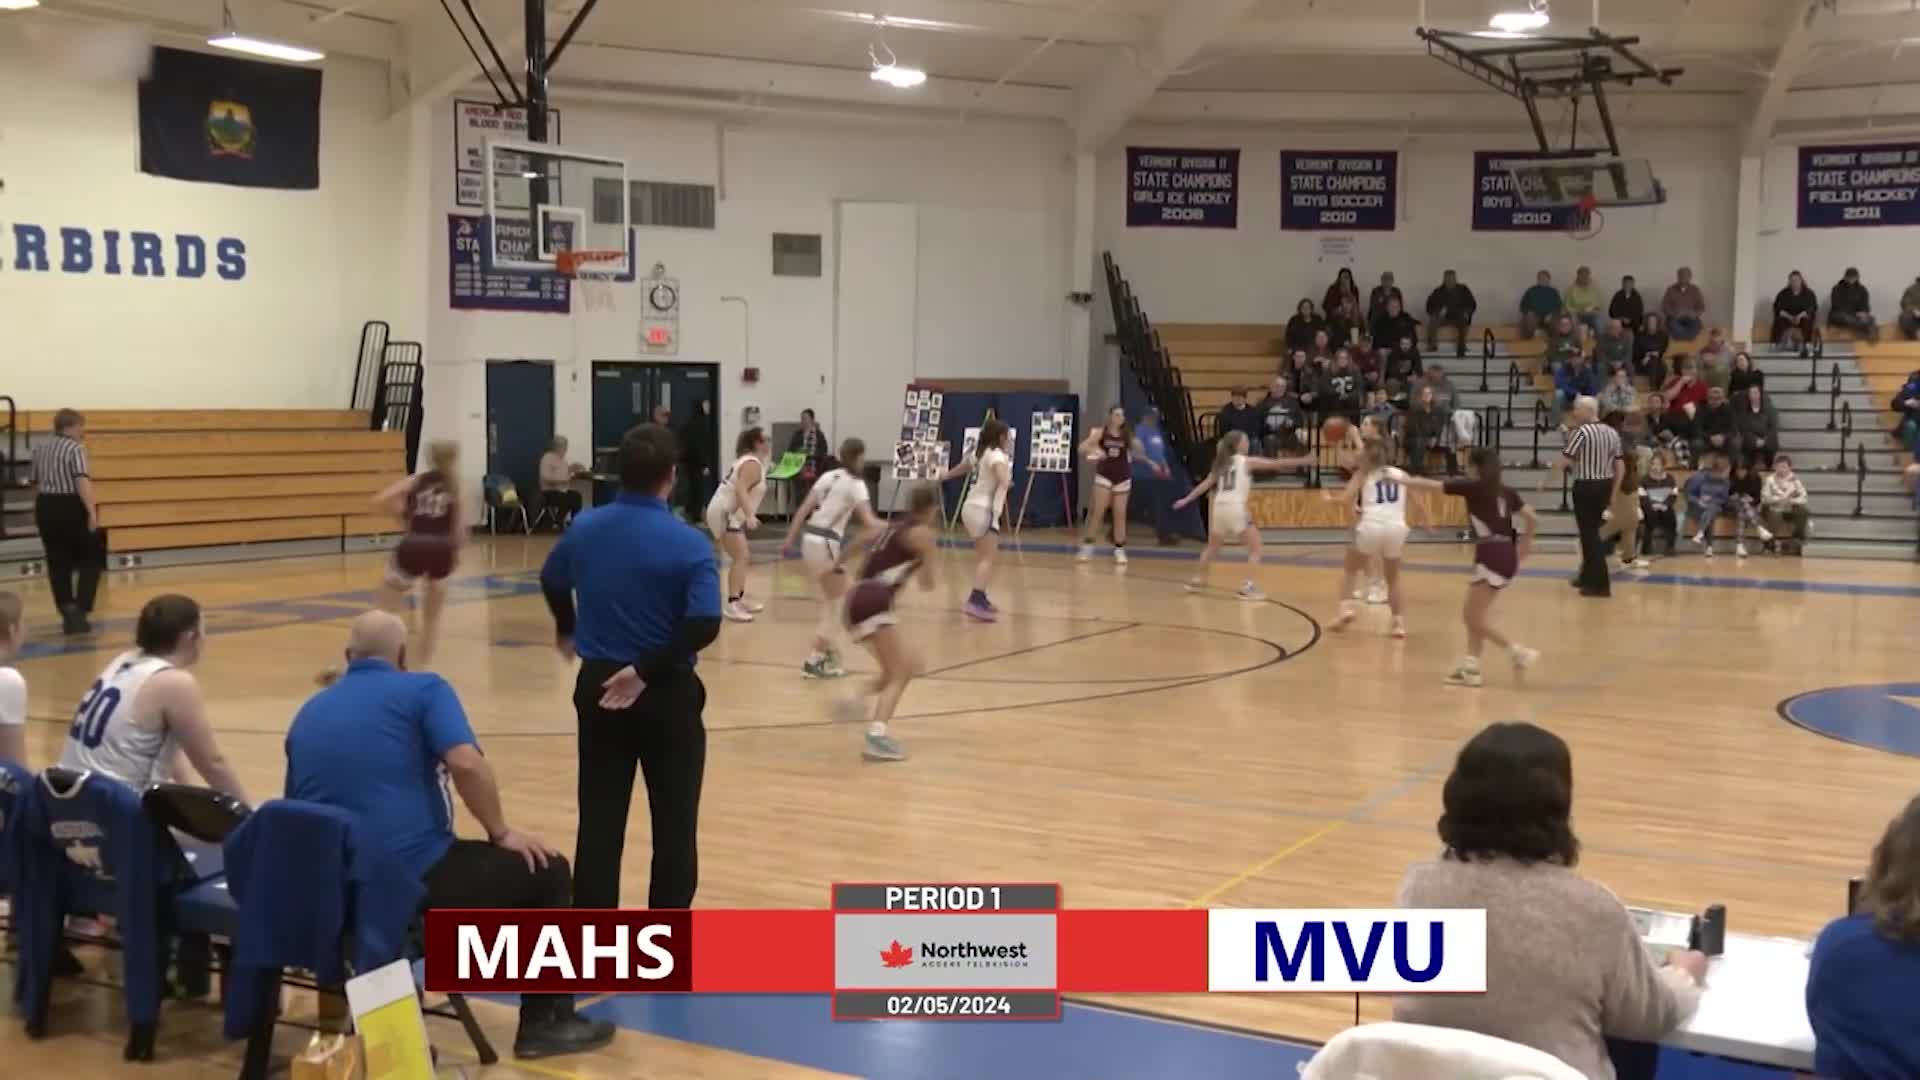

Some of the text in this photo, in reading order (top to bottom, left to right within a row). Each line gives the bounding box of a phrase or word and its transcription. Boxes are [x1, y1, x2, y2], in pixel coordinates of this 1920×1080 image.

[1138, 155, 1177, 168] VERMONT
[1181, 156, 1217, 169] DIVISION
[1295, 159, 1334, 171] VERMONT
[1337, 159, 1373, 171] DIVISION
[1812, 154, 1856, 166] VERMONT
[1861, 151, 1903, 165] DIVISION
[1134, 171, 1232, 189] STATE CHAMPIONS
[1291, 175, 1386, 191] STATE CHAMPIONS
[1808, 171, 1847, 187] STATE
[1134, 190, 1231, 205] GIRLS ICE HOCKEY
[1293, 195, 1383, 207] BOYS SOCCER
[1481, 196, 1513, 209] BOYS
[1809, 188, 1918, 204] FIELD HOCKEY
[1320, 210, 1357, 223] 2010
[1511, 213, 1551, 225] 2010
[1843, 206, 1880, 219] 2011
[0, 223, 248, 281] RBIRDS
[1376, 479, 1399, 505] 10
[70, 677, 121, 750] 20
